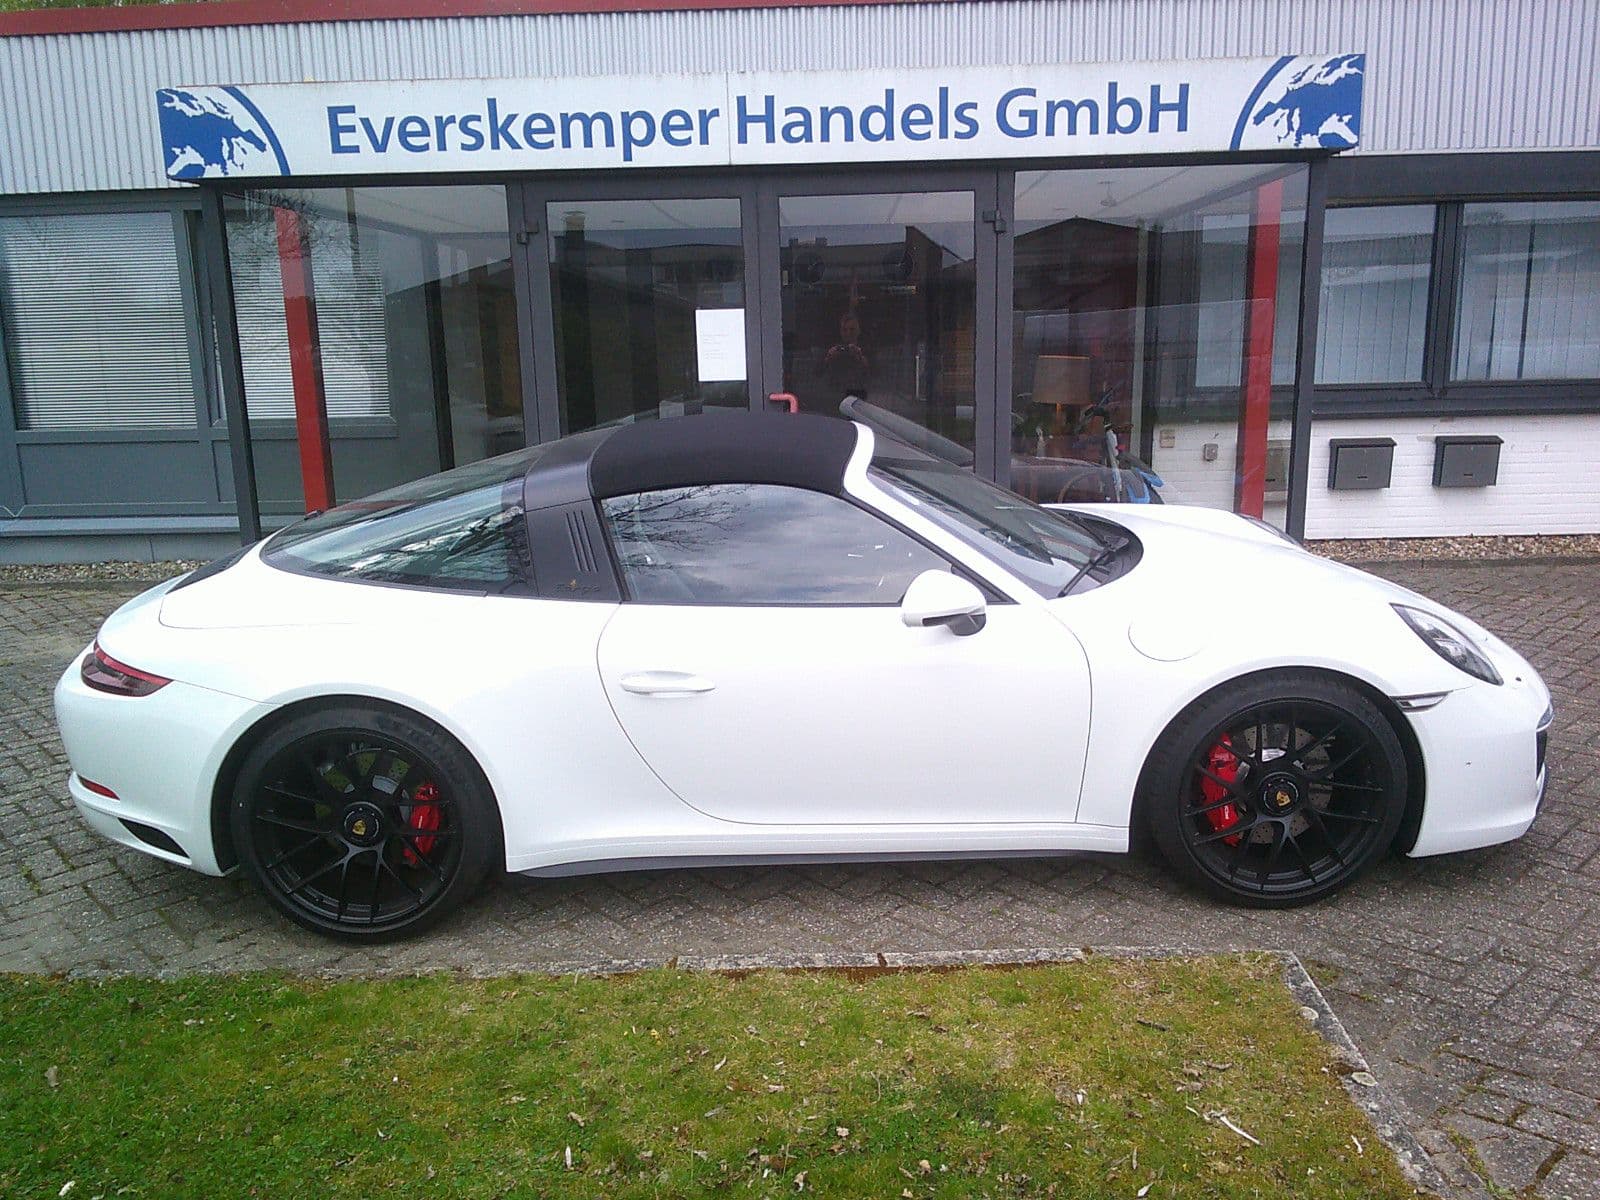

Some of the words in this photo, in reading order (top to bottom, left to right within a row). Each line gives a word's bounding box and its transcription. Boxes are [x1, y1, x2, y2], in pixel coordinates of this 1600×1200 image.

[328, 97, 721, 162] Everskemper
[737, 87, 979, 145] Handels
[996, 81, 1190, 138] GmbH
